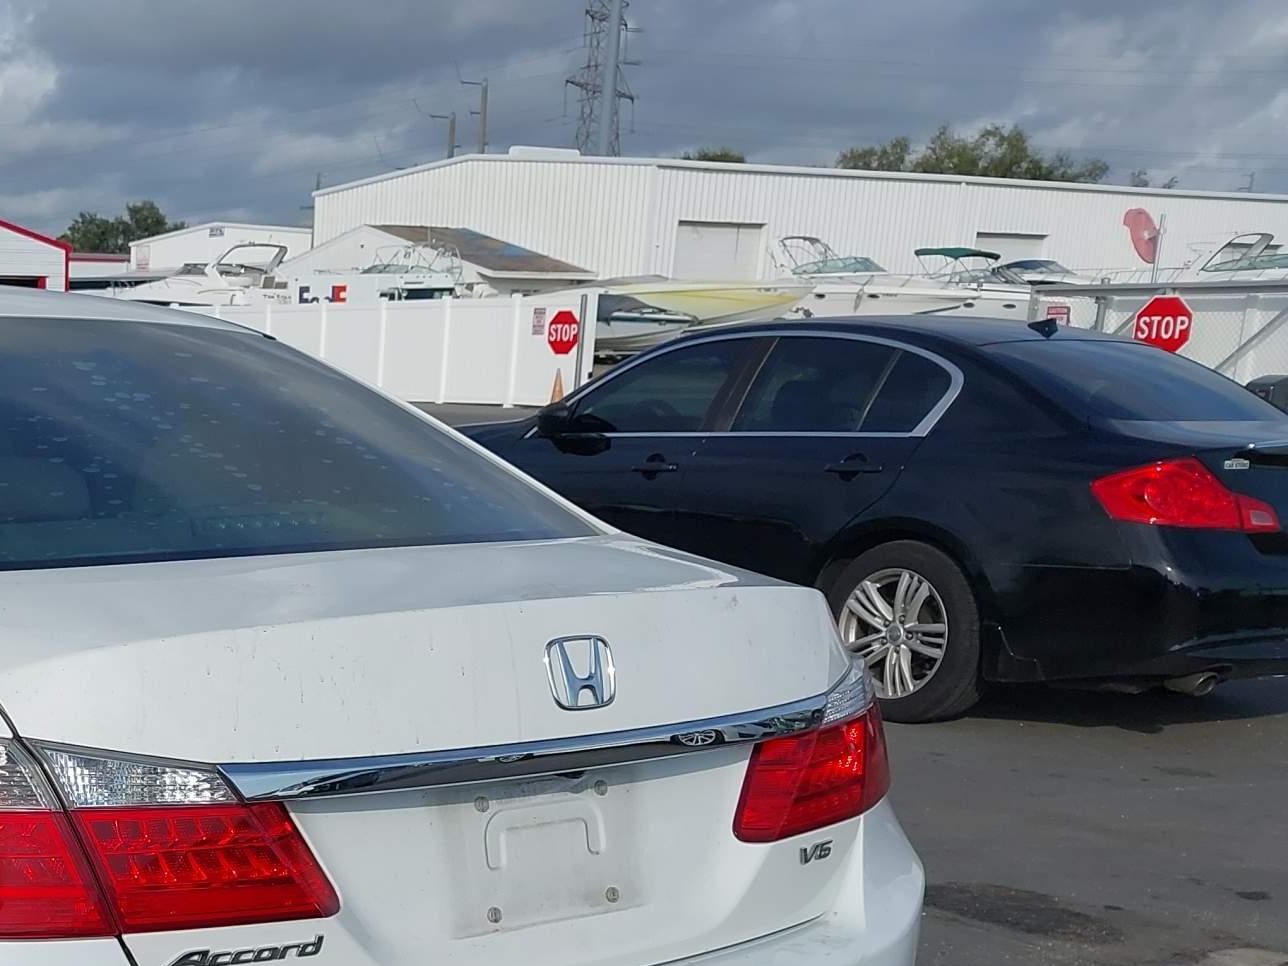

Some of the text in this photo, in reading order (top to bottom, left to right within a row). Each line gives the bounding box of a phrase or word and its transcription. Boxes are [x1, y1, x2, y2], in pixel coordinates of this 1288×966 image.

[549, 323, 578, 342] STOP
[1137, 316, 1189, 340] STOP
[799, 840, 833, 866] V6
